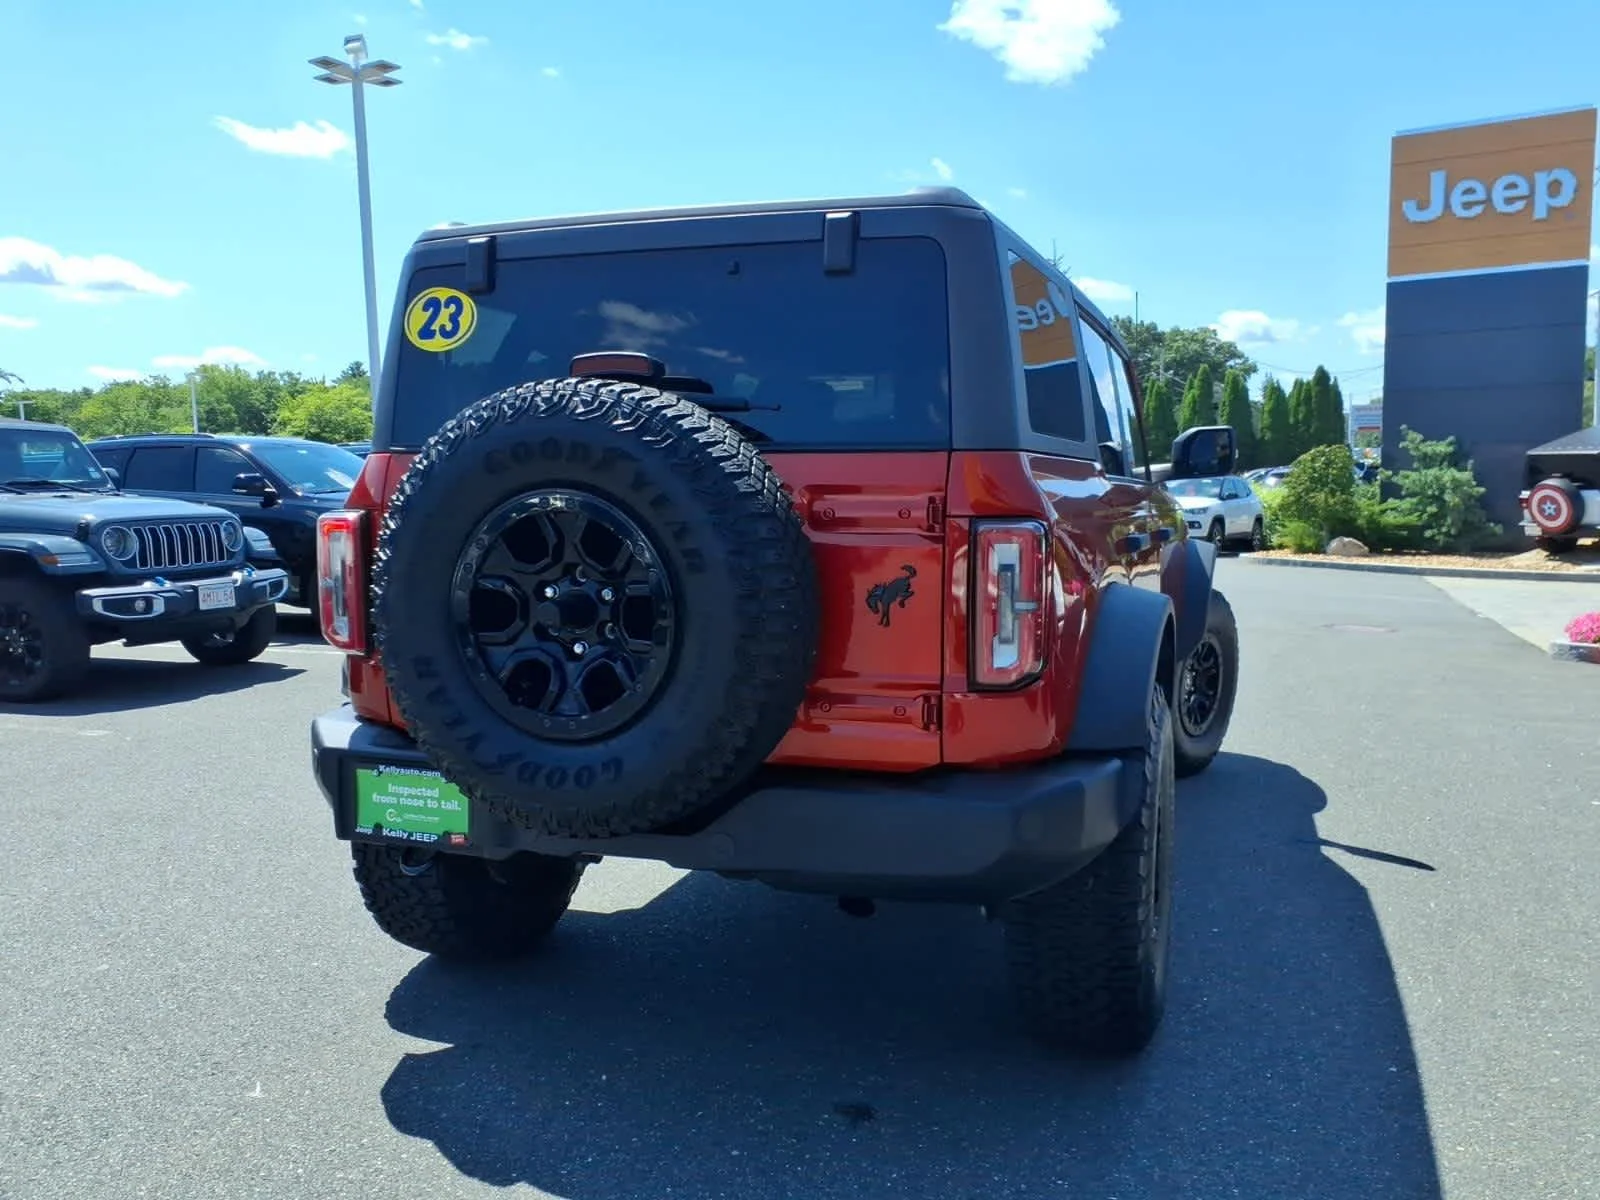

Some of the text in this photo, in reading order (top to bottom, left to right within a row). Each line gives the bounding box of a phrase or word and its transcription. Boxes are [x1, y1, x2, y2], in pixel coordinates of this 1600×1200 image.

[1402, 168, 1577, 223] Jeep
[417, 295, 464, 340] 23
[388, 783, 439, 797] Inspected
[372, 792, 462, 810] from nose to tail.
[382, 828, 438, 842] Kelly JEEP
